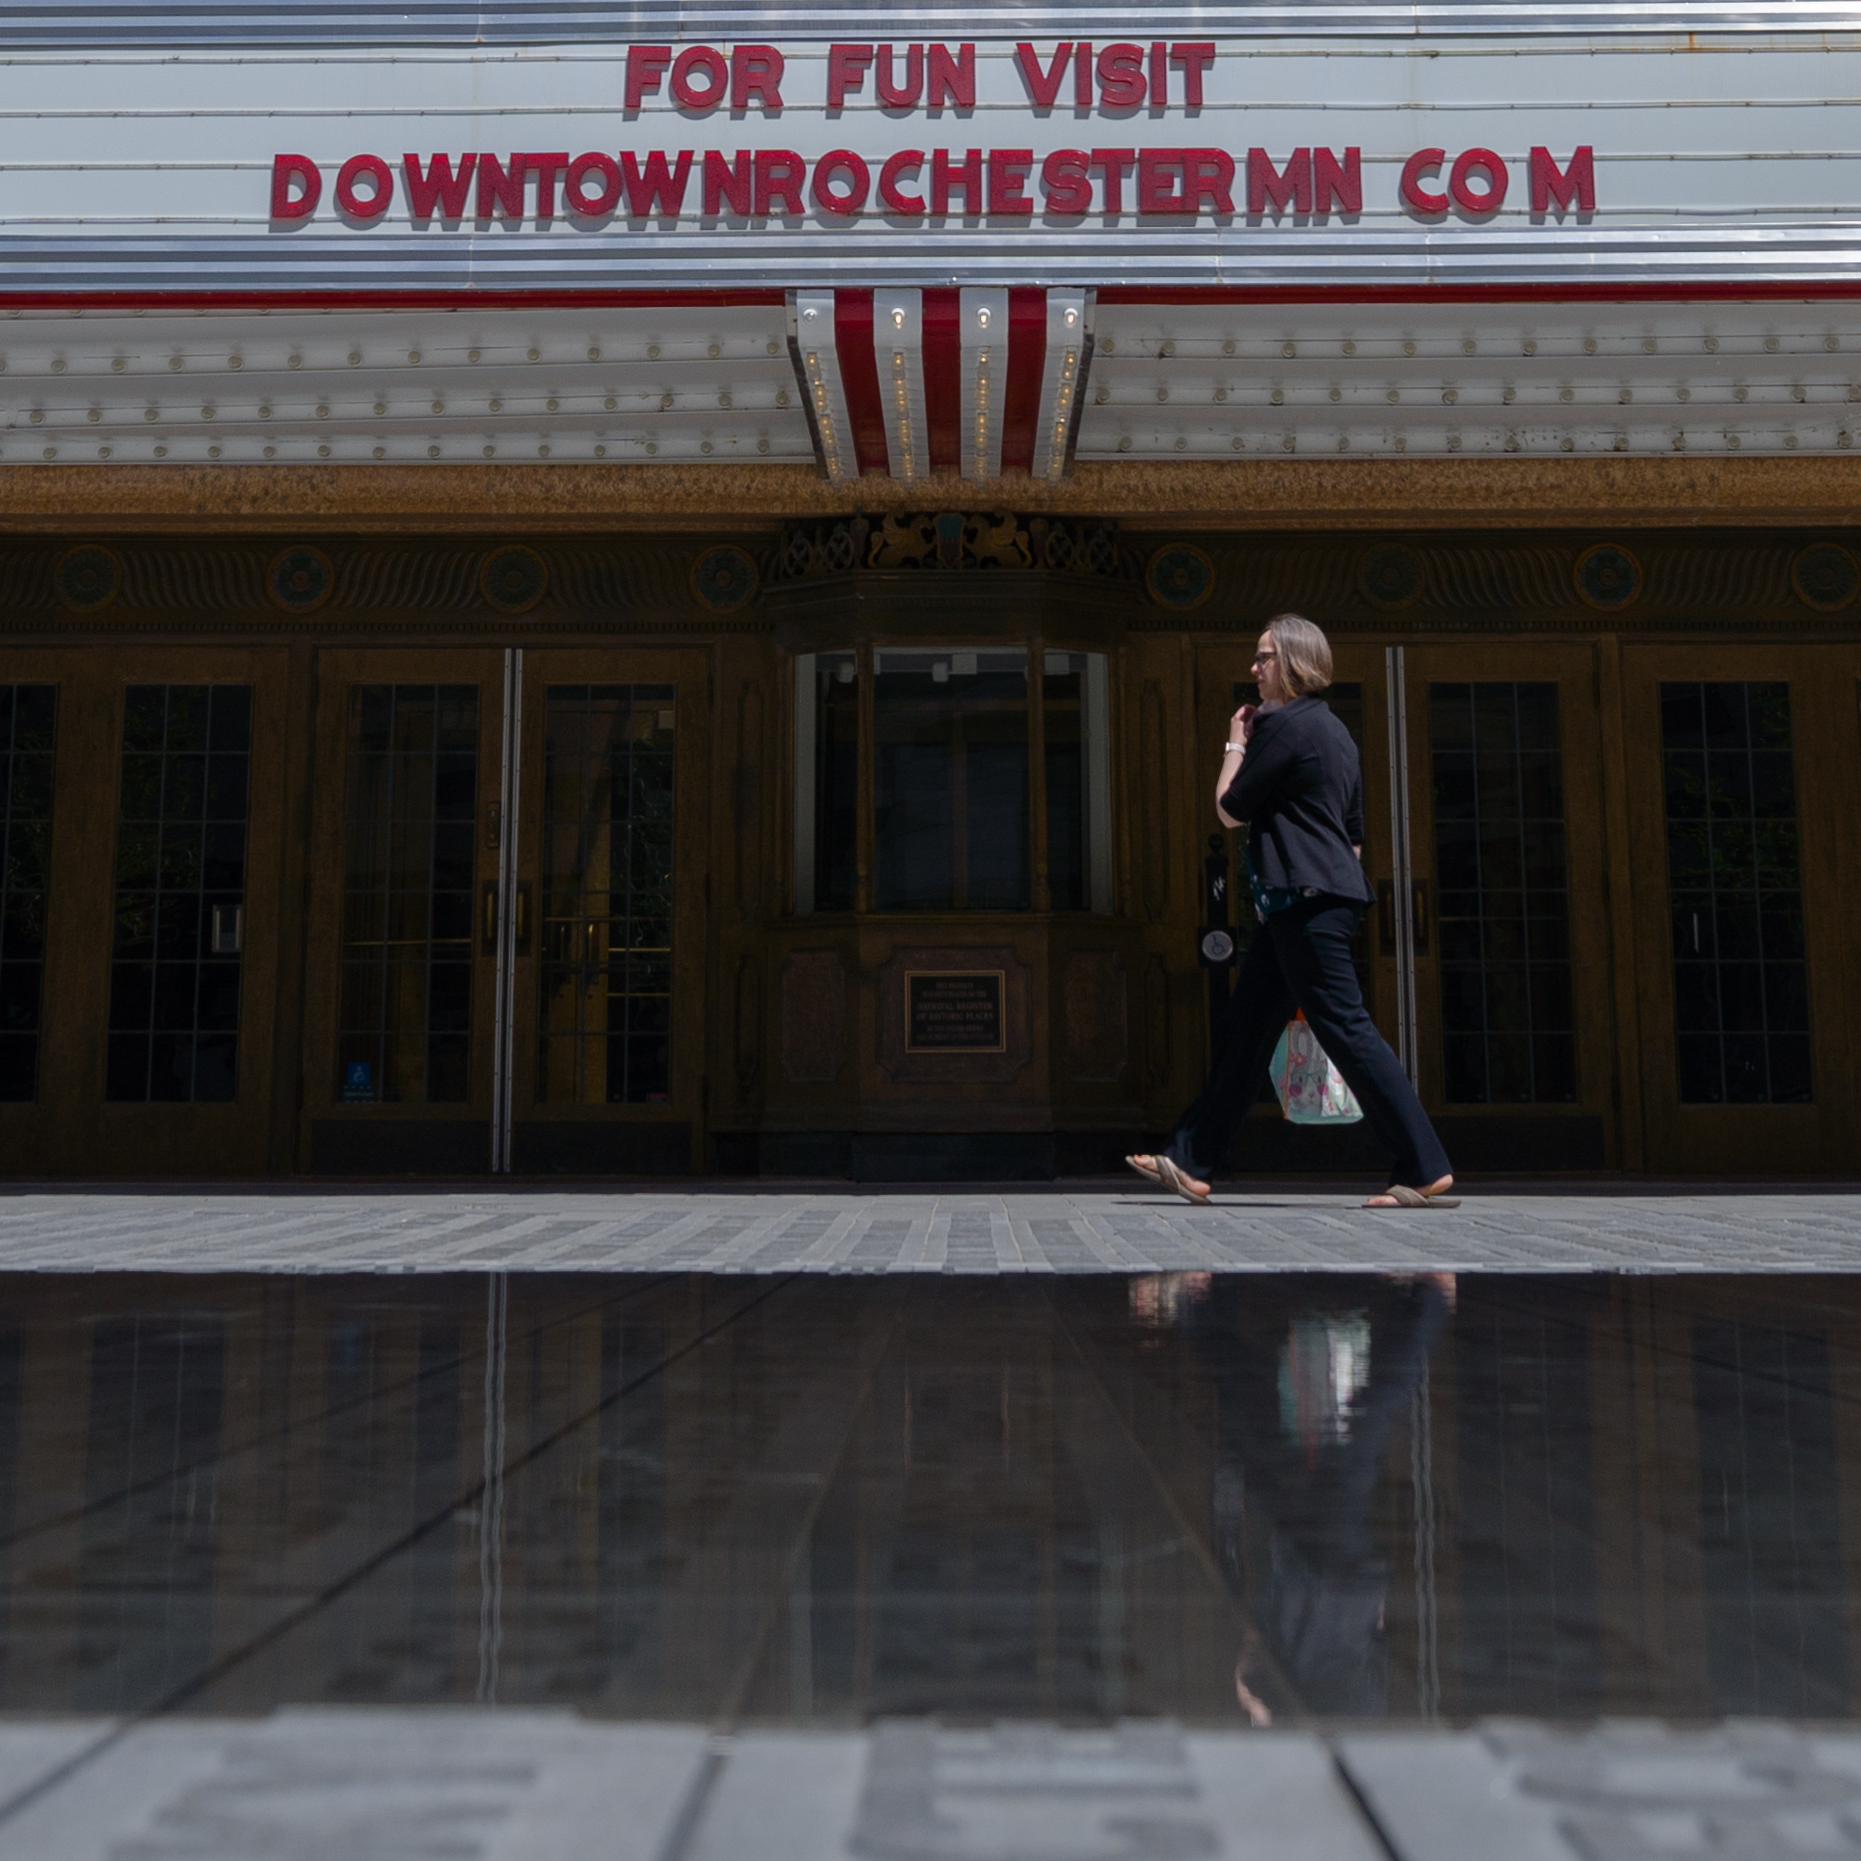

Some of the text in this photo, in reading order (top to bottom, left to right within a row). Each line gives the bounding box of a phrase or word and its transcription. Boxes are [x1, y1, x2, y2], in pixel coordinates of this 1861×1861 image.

[626, 41, 1216, 110] FOR FUN VISIT
